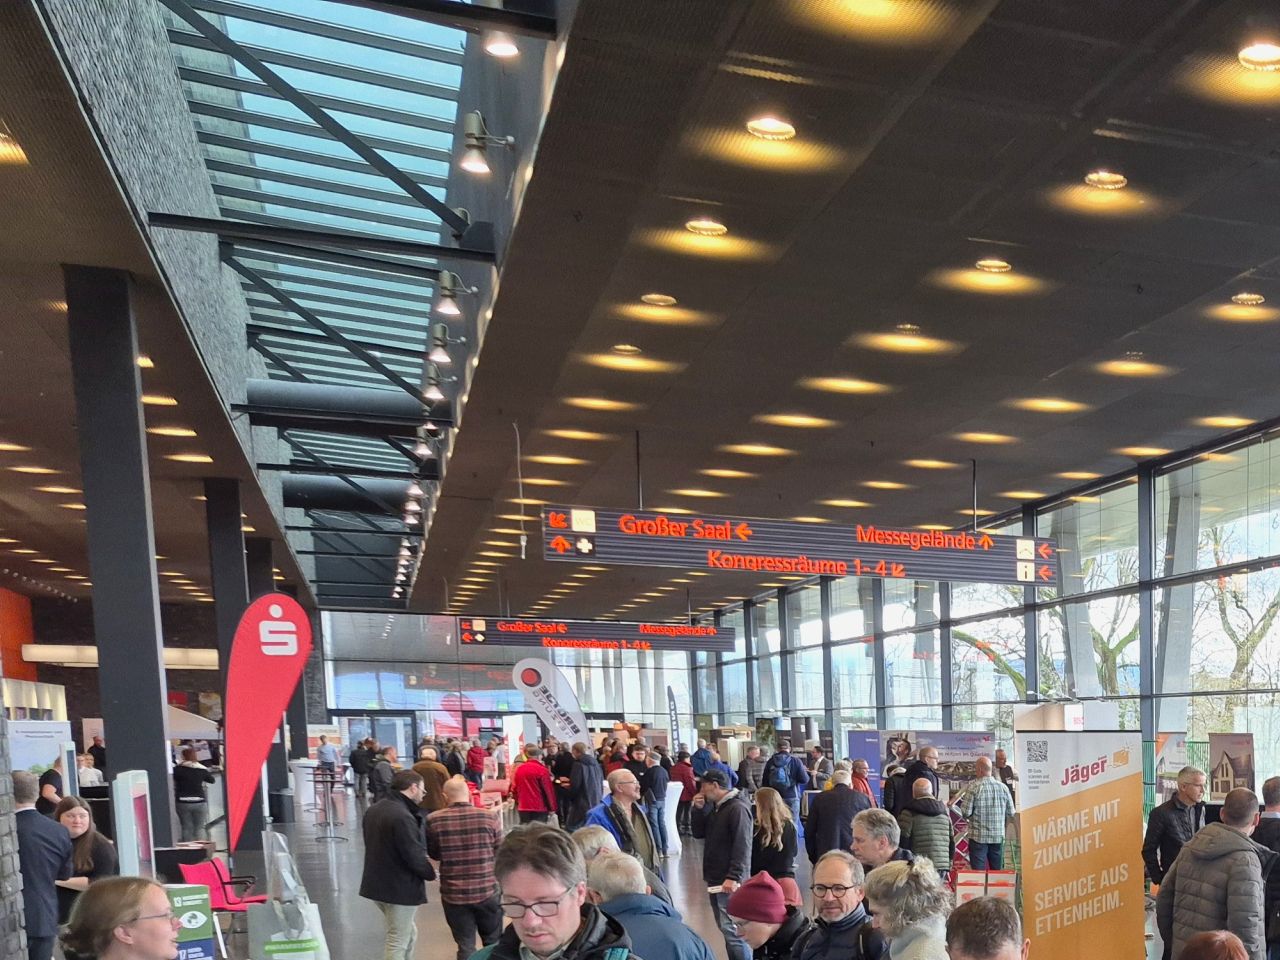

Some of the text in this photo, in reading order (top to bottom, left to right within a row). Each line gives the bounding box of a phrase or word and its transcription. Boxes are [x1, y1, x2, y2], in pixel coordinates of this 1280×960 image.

[618, 514, 731, 540] Großer Saal
[856, 524, 976, 551] Messegelände
[707, 549, 847, 576] Kongressräume
[496, 621, 557, 634] Großer Saal
[639, 623, 708, 636] Messegelände
[542, 637, 619, 650] Kongressräume
[1061, 758, 1107, 786] Jäger
[1033, 799, 1121, 845] WÄRME MIT
[1033, 829, 1104, 870] ZUKUNFT.
[1035, 863, 1129, 912] SERVICE AUS
[1036, 890, 1124, 937] ETTENHEIM.
